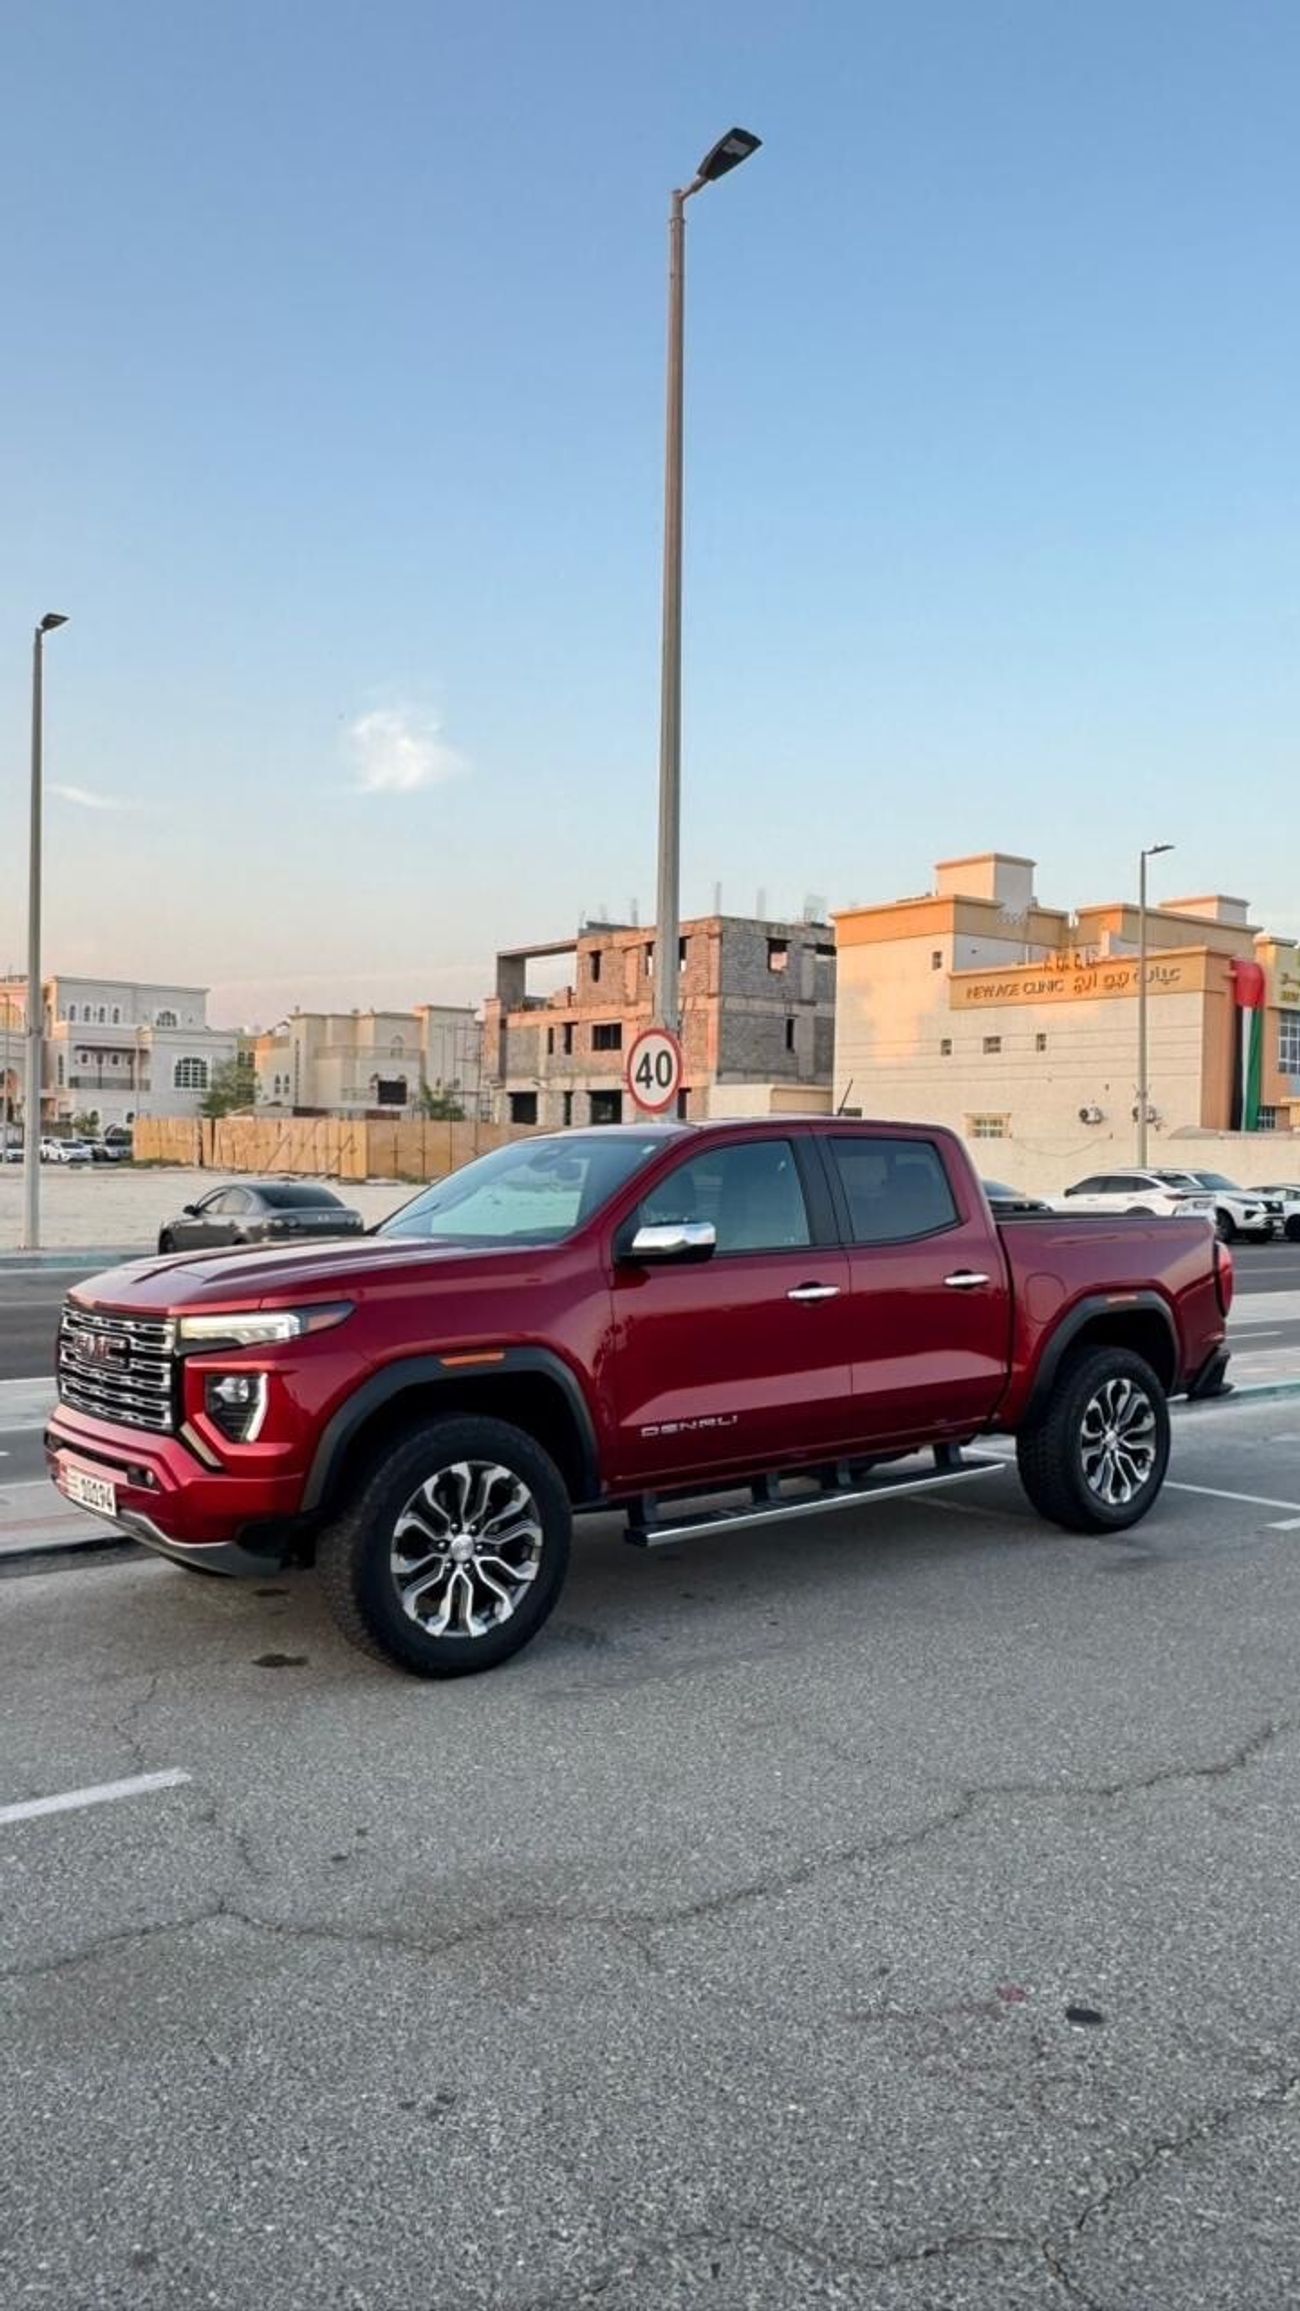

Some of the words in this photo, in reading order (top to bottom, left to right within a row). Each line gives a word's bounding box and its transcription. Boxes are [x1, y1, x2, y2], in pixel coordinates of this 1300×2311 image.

[1023, 979, 1064, 995] CLINIC
[636, 1050, 673, 1089] 40
[641, 1415, 738, 1437] DENALI
